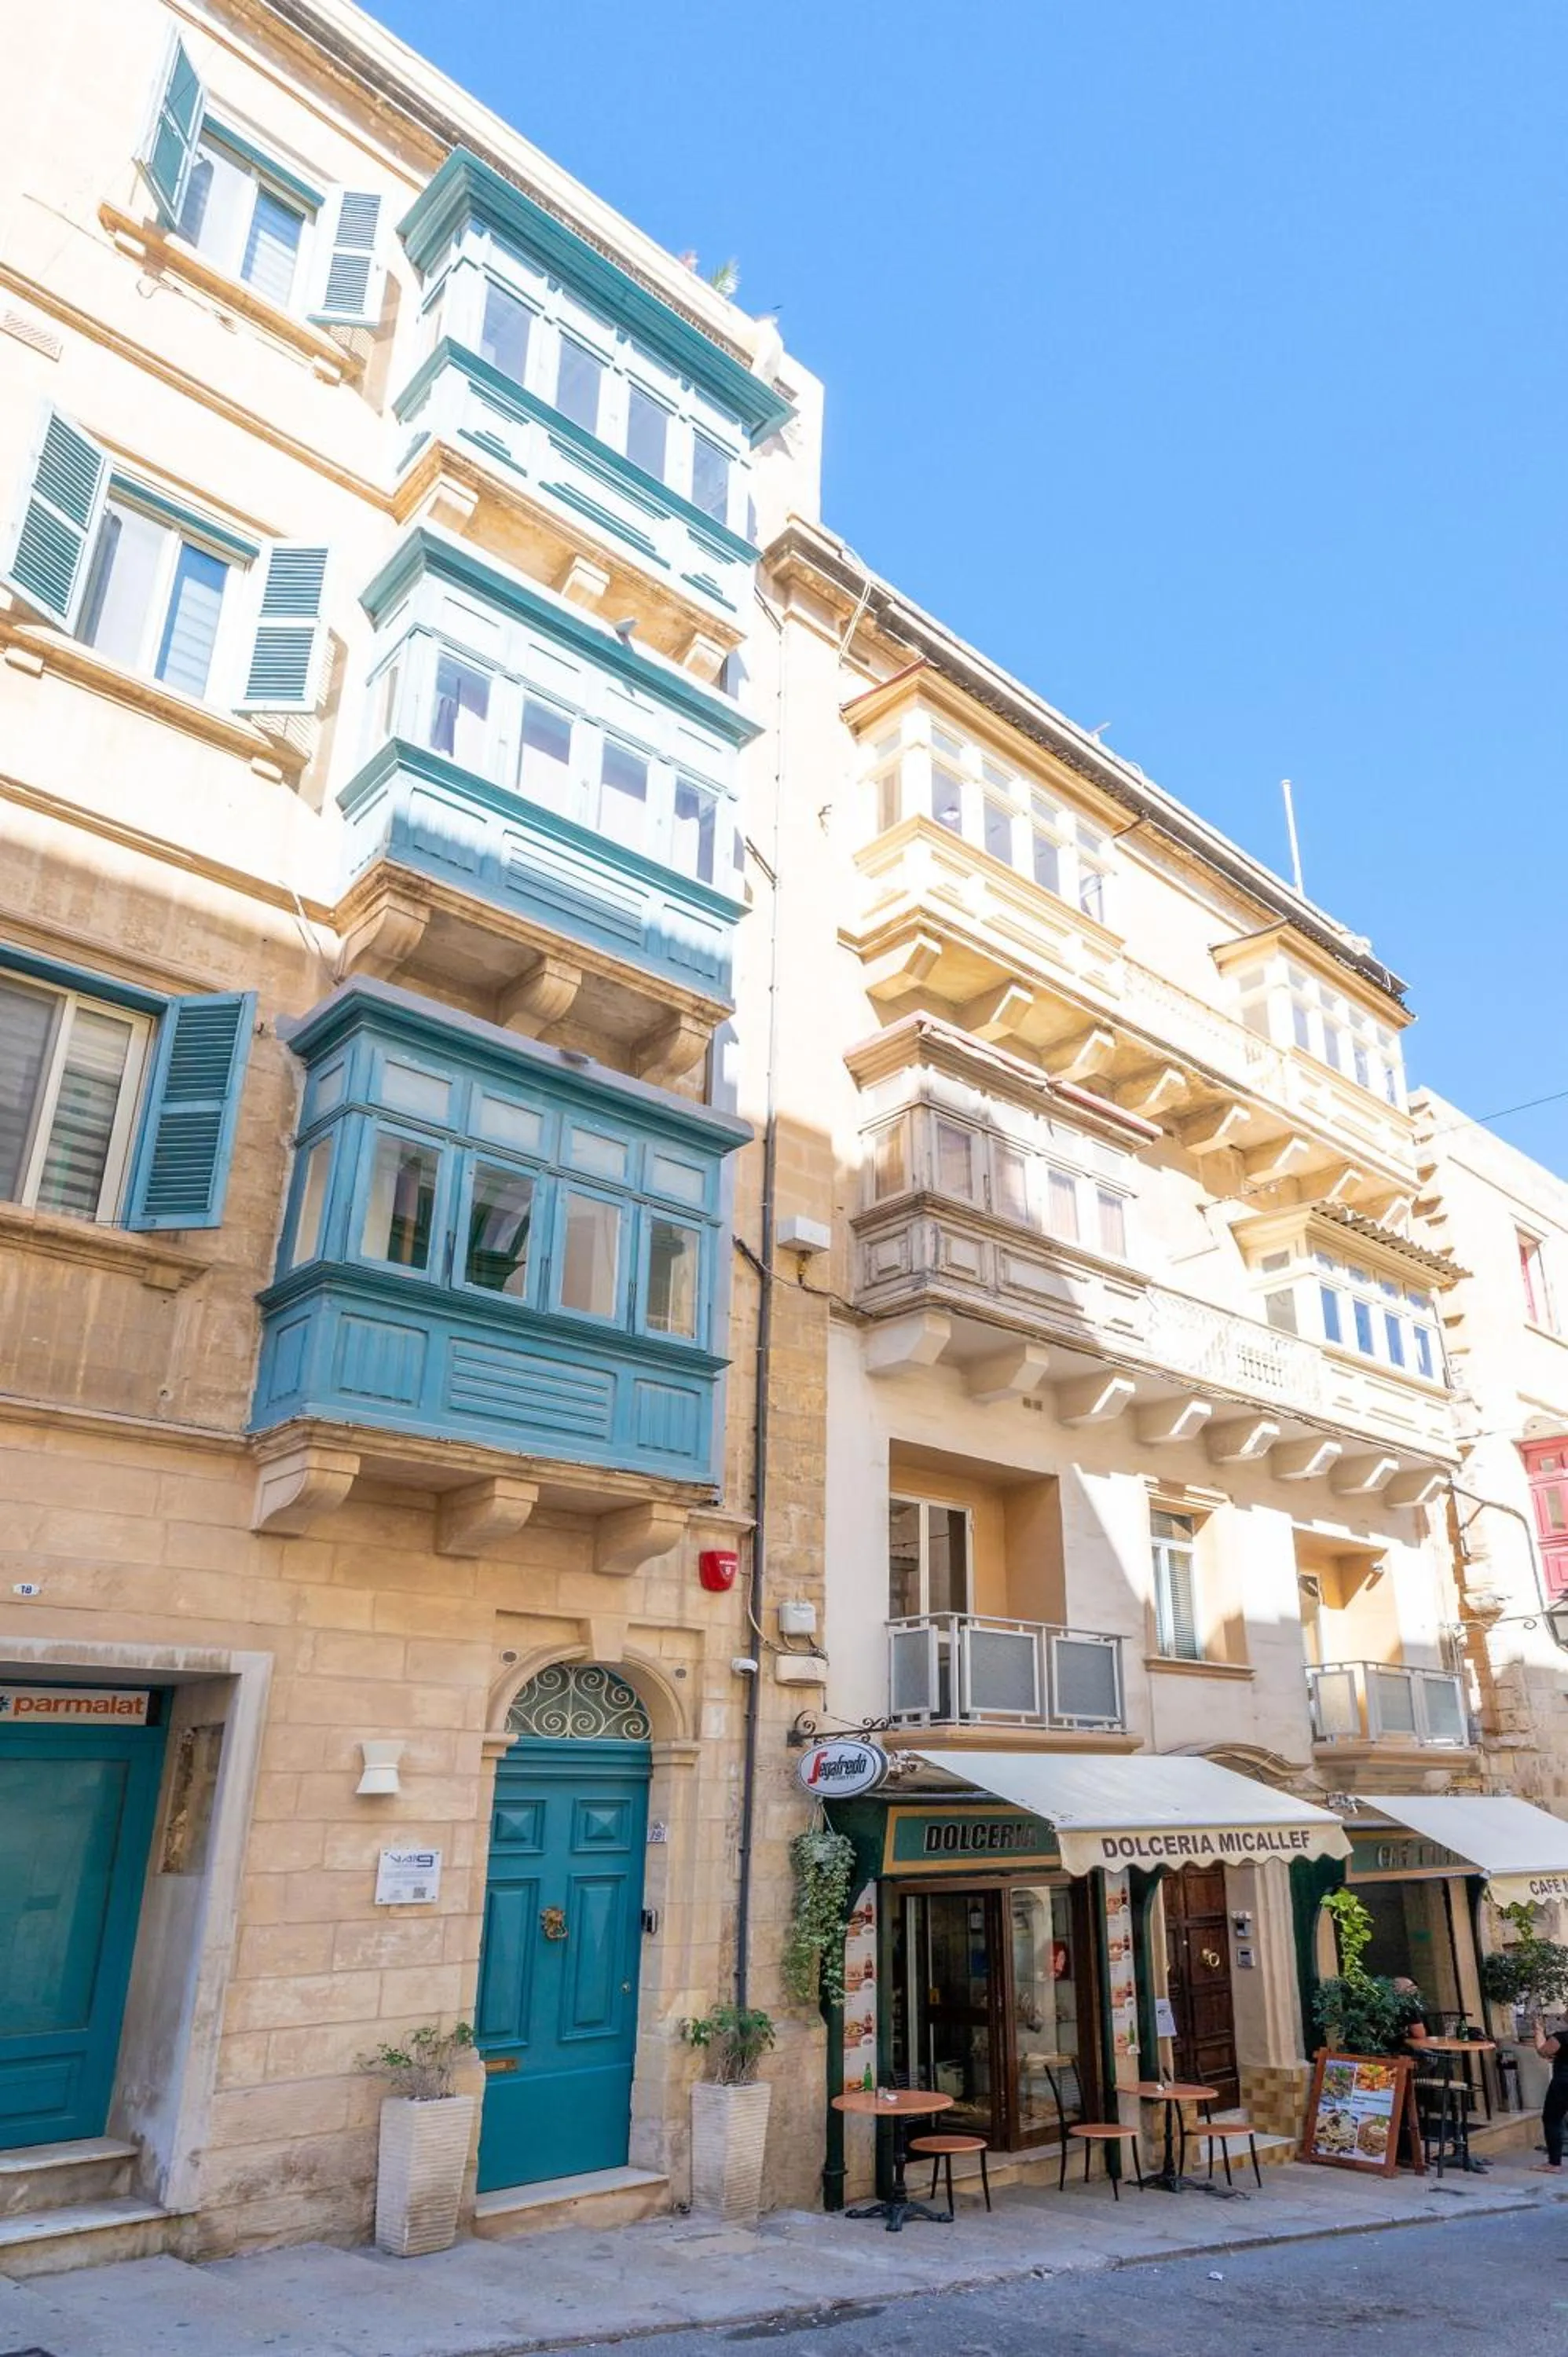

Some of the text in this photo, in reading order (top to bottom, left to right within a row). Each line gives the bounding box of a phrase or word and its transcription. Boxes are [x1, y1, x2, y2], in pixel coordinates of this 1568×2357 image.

[13, 1695, 144, 1716] parmalat
[808, 1751, 867, 1784] Segafredo
[1101, 1831, 1310, 1858] DOLCERIA MICALLEF
